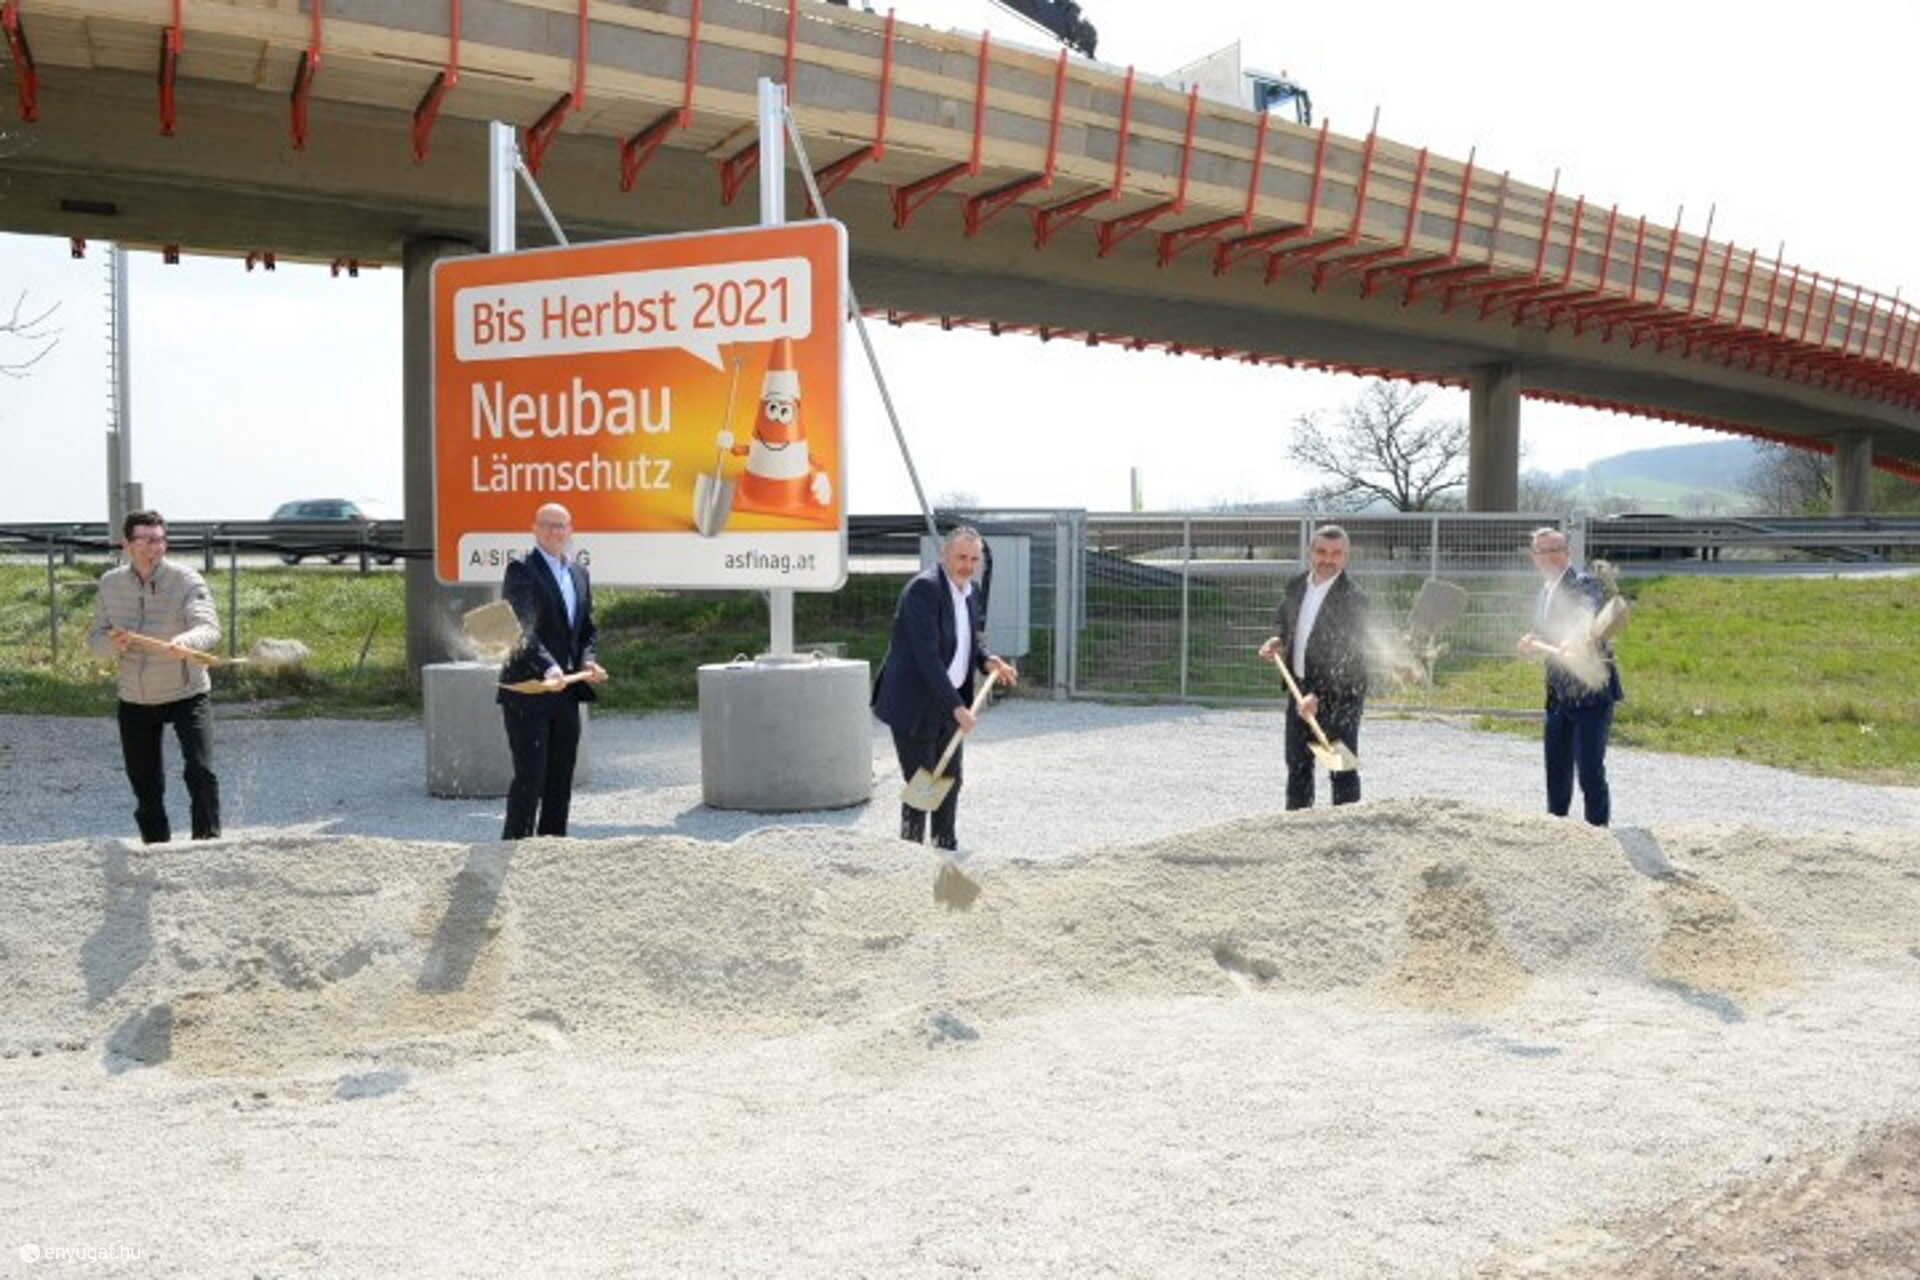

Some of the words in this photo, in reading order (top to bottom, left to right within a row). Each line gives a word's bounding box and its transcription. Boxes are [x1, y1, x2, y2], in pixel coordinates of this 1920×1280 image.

[473, 298, 525, 345] Bis
[542, 289, 676, 339] Herbst
[693, 275, 791, 329] 2021
[471, 377, 671, 440] Neubau
[471, 452, 671, 493] Lärmschutz
[725, 551, 816, 574] asfinag.at
